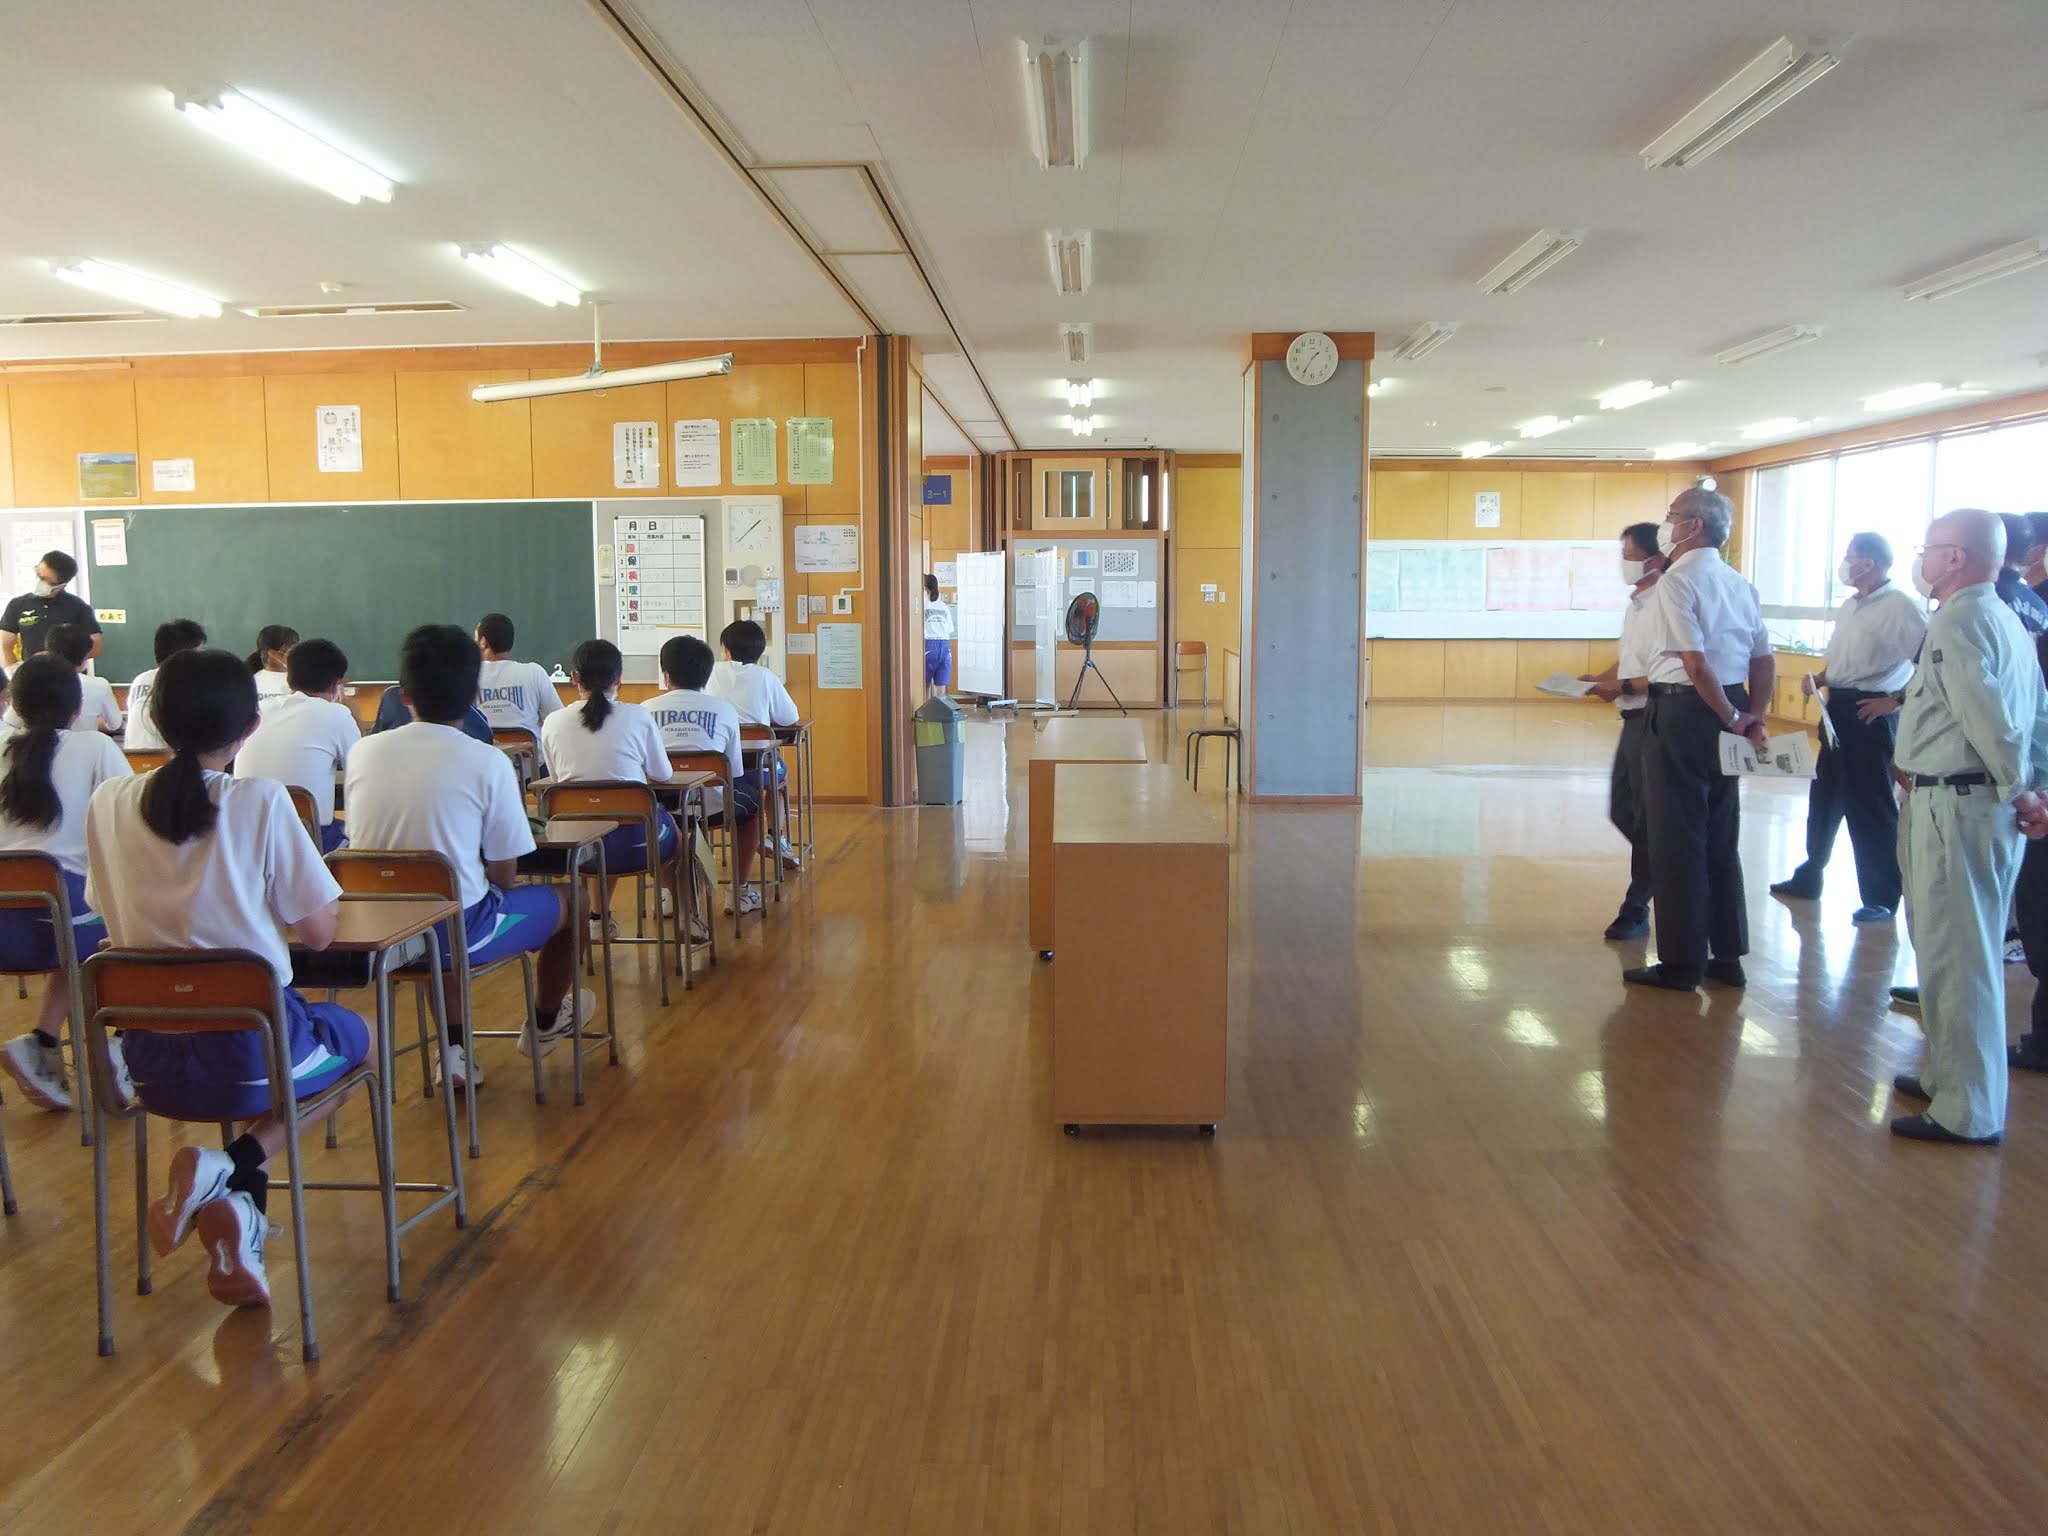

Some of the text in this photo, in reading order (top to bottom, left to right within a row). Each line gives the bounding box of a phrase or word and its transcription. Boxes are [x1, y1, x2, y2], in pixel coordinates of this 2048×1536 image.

[629, 521, 657, 531] 月 日
[628, 555, 637, 566] 保
[629, 585, 638, 595] 理
[478, 686, 525, 711] IRACHU
